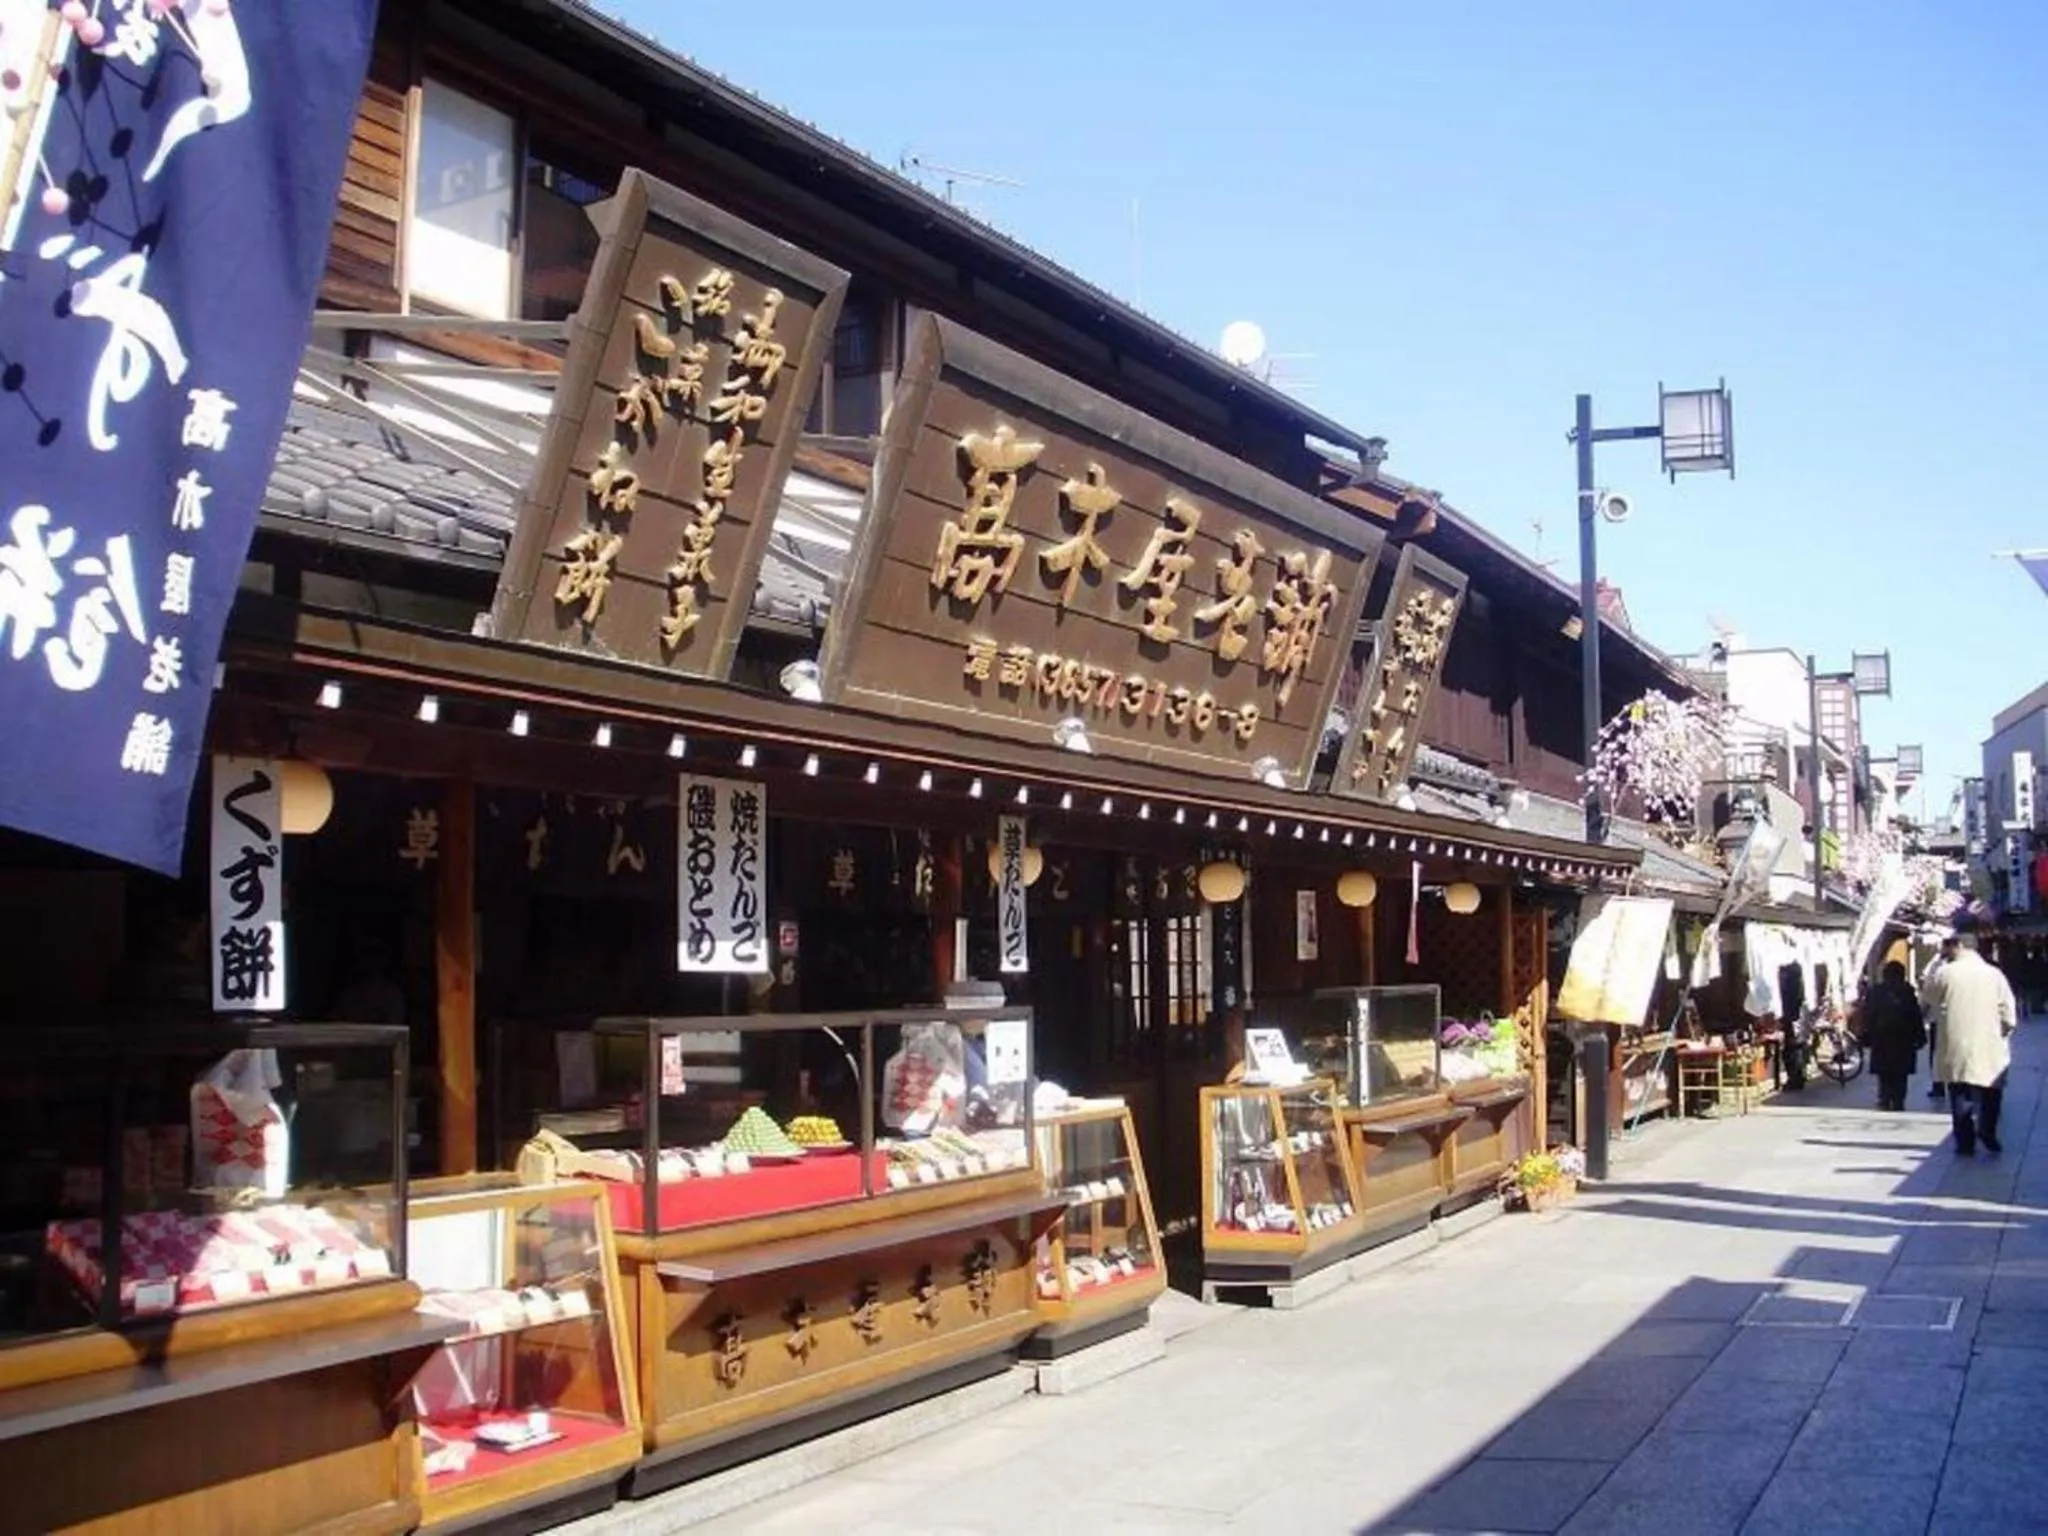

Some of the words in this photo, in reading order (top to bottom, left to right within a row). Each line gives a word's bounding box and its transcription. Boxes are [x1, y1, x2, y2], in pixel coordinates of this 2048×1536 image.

[932, 425, 1338, 706] 高木屋老舗
[220, 769, 279, 1001] くず餅
[730, 789, 761, 963] 焼だんご
[1004, 822, 1023, 967] 草だんご
